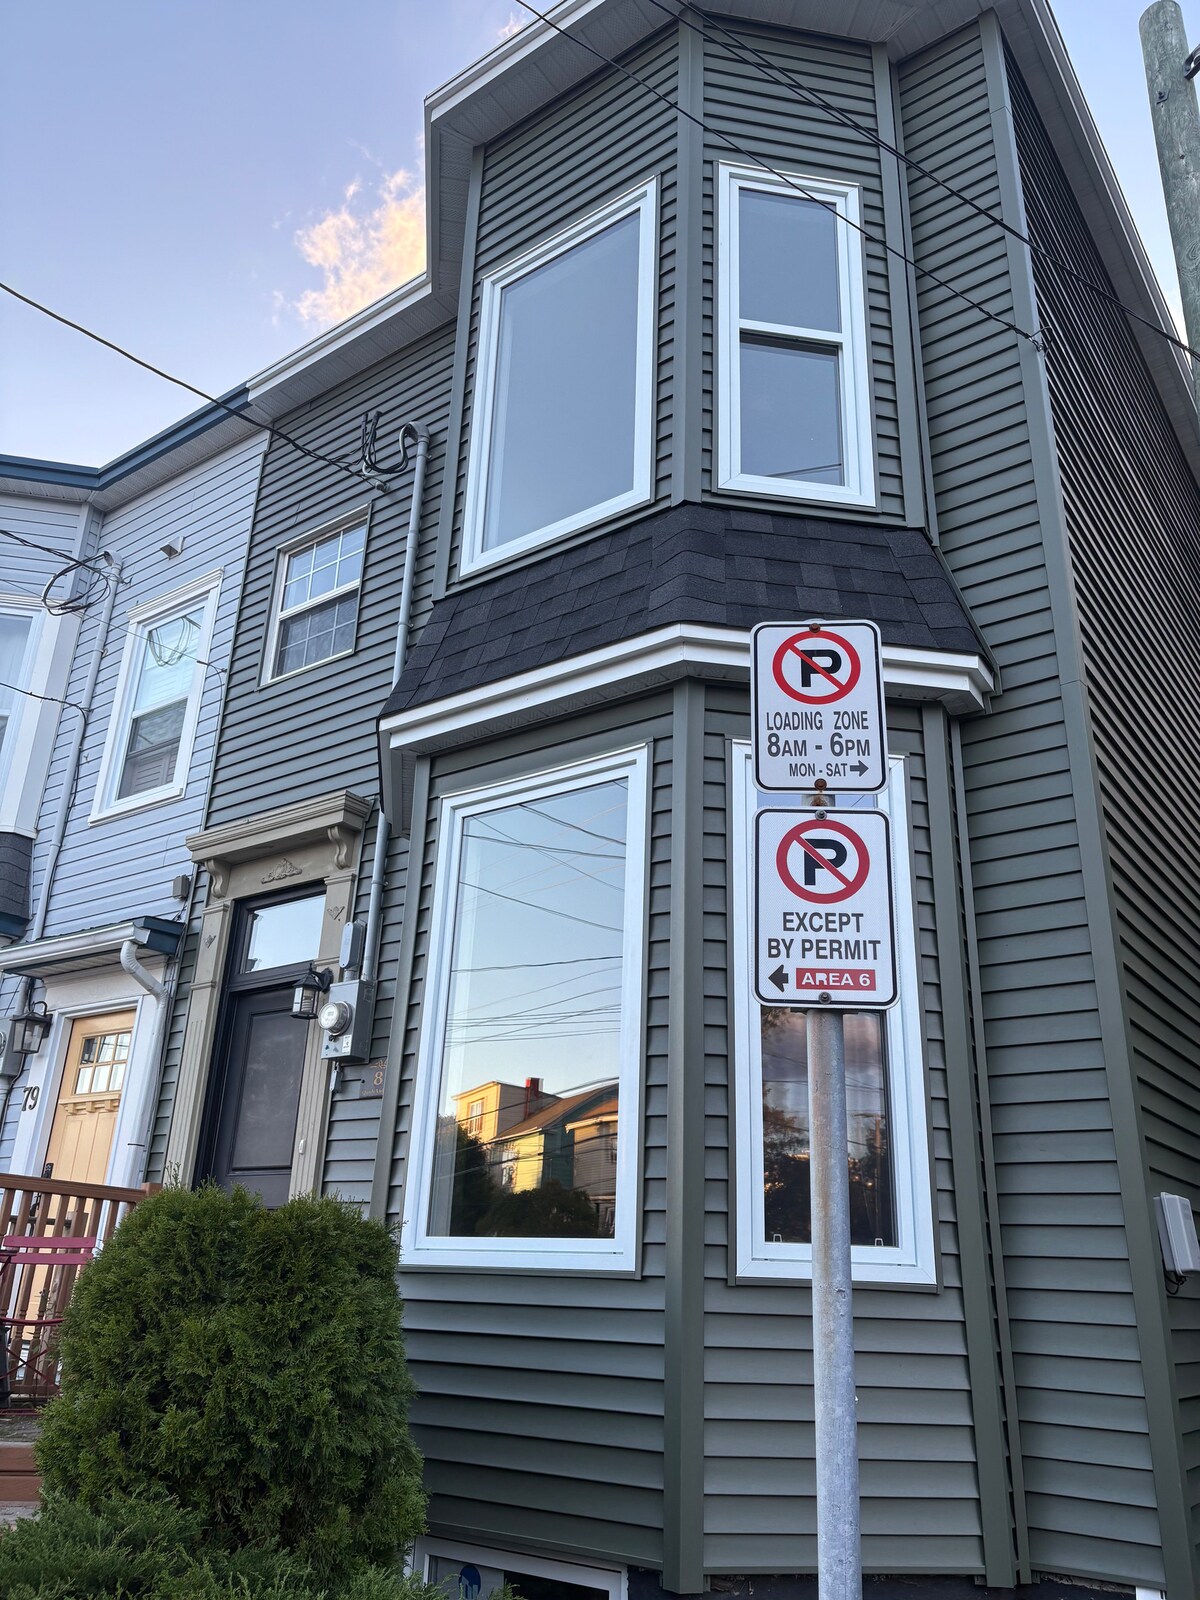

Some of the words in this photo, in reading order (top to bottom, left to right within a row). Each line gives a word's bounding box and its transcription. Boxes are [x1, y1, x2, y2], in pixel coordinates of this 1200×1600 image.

[766, 711, 823, 731] LOADING
[833, 710, 869, 730] ZONE
[767, 732, 808, 758] 8AM
[830, 732, 871, 757] 6PM
[789, 763, 816, 777] MON
[826, 763, 848, 777] SAT
[782, 911, 864, 933] EXCEPT
[767, 938, 795, 959] BY
[801, 939, 881, 961] PERMIT
[801, 972, 855, 986] AREA
[858, 973, 871, 986] 6
[21, 1085, 40, 1111] 79
